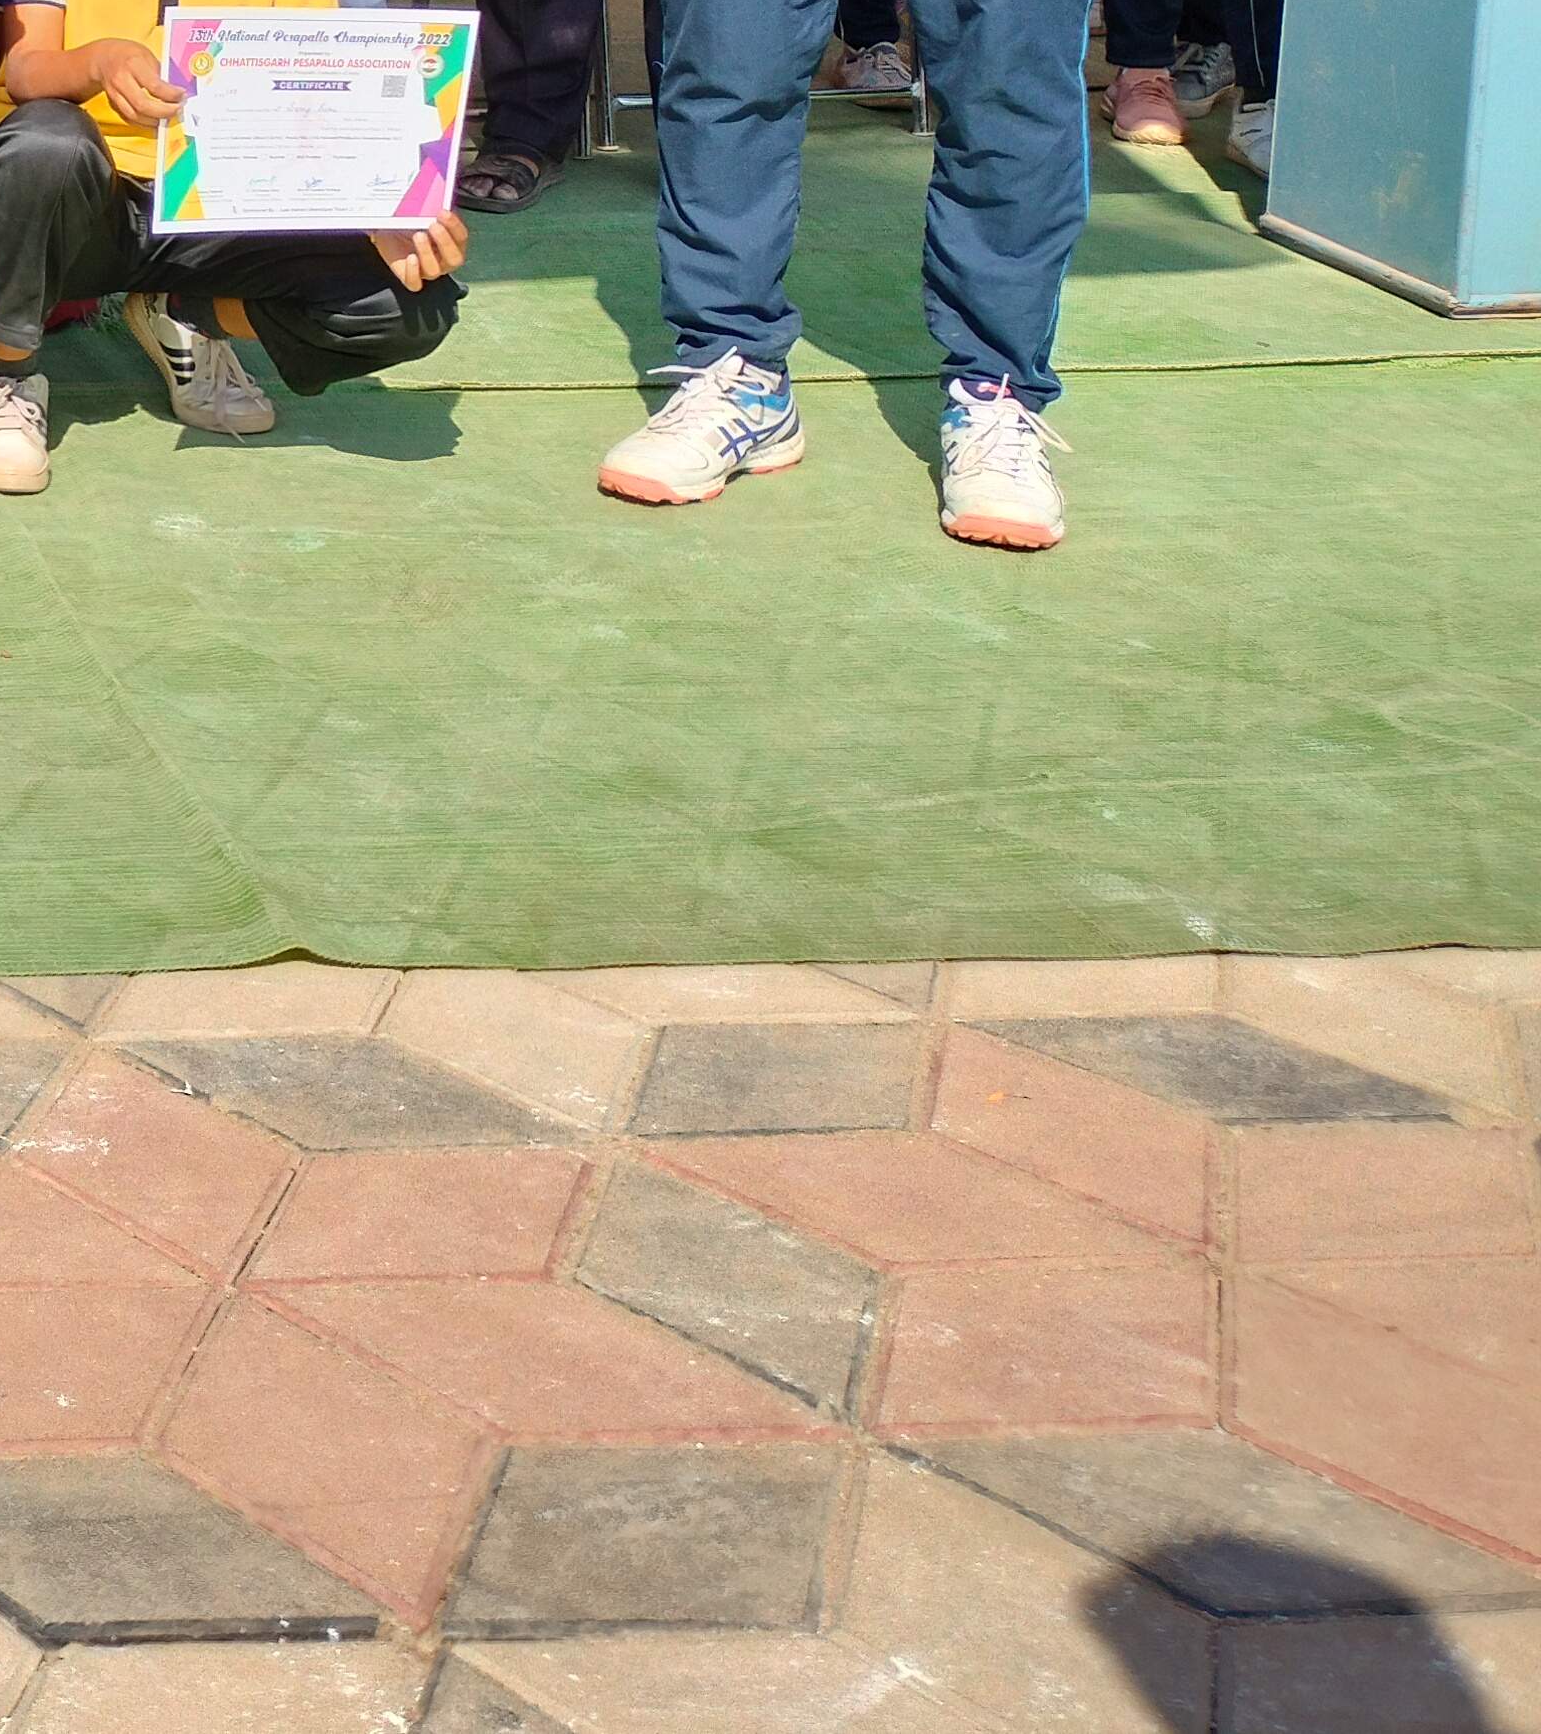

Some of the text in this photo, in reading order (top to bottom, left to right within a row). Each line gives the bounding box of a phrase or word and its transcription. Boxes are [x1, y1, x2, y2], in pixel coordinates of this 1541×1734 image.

[189, 28, 450, 48] 13th National Pesapallo Championship 2022
[220, 57, 411, 69] CHHATTISGARH PESAPALLO ASSOCIATION
[278, 81, 345, 90] CERTIFICATE
